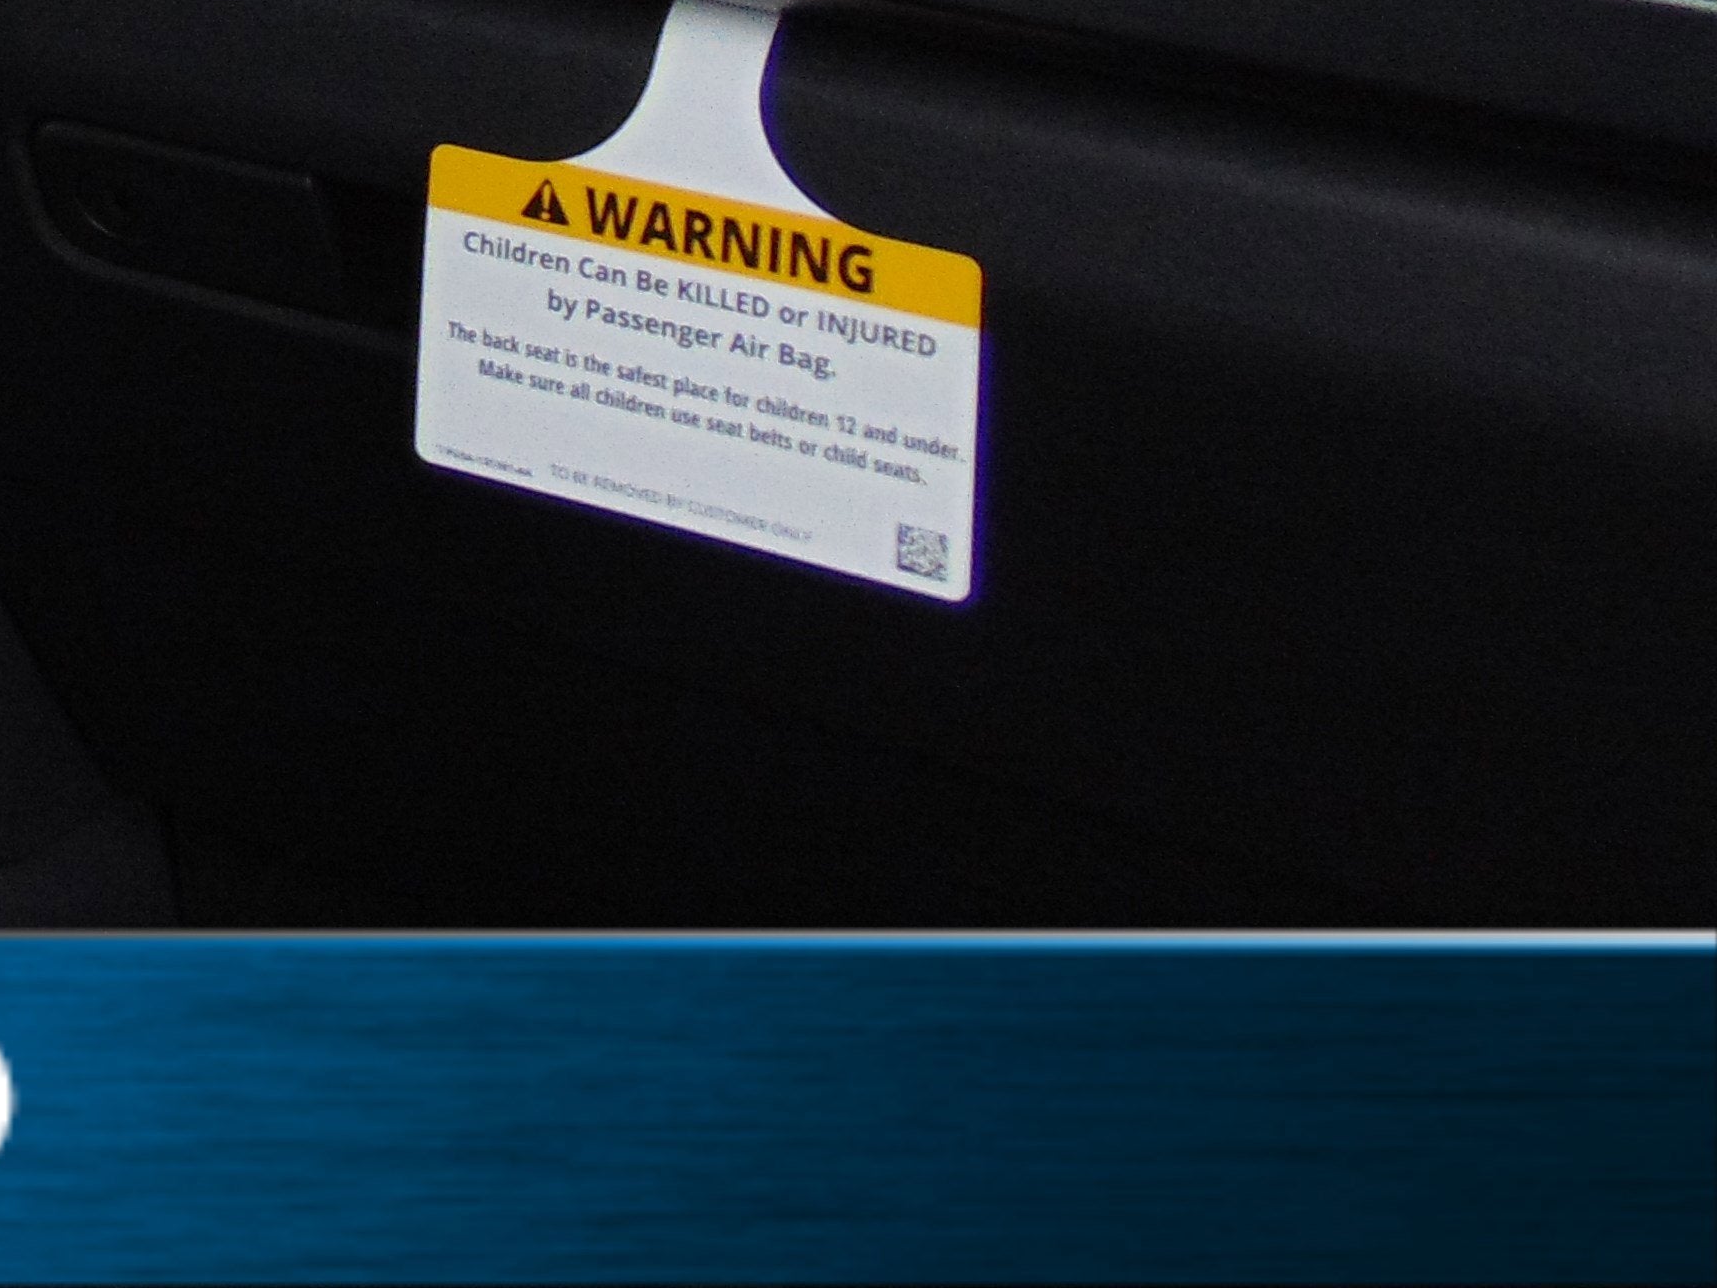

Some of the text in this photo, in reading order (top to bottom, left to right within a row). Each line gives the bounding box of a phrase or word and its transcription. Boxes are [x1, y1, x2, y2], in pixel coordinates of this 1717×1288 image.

[463, 231, 937, 357] Children Can Be KILLED or INJURED
[586, 185, 875, 294] WARNING
[448, 320, 967, 465] The back seat is the safest place for children 12 and under.
[547, 288, 836, 380] by Passenger Air Bag.
[478, 357, 929, 487] Make sure all children use seat belts or child seats.
